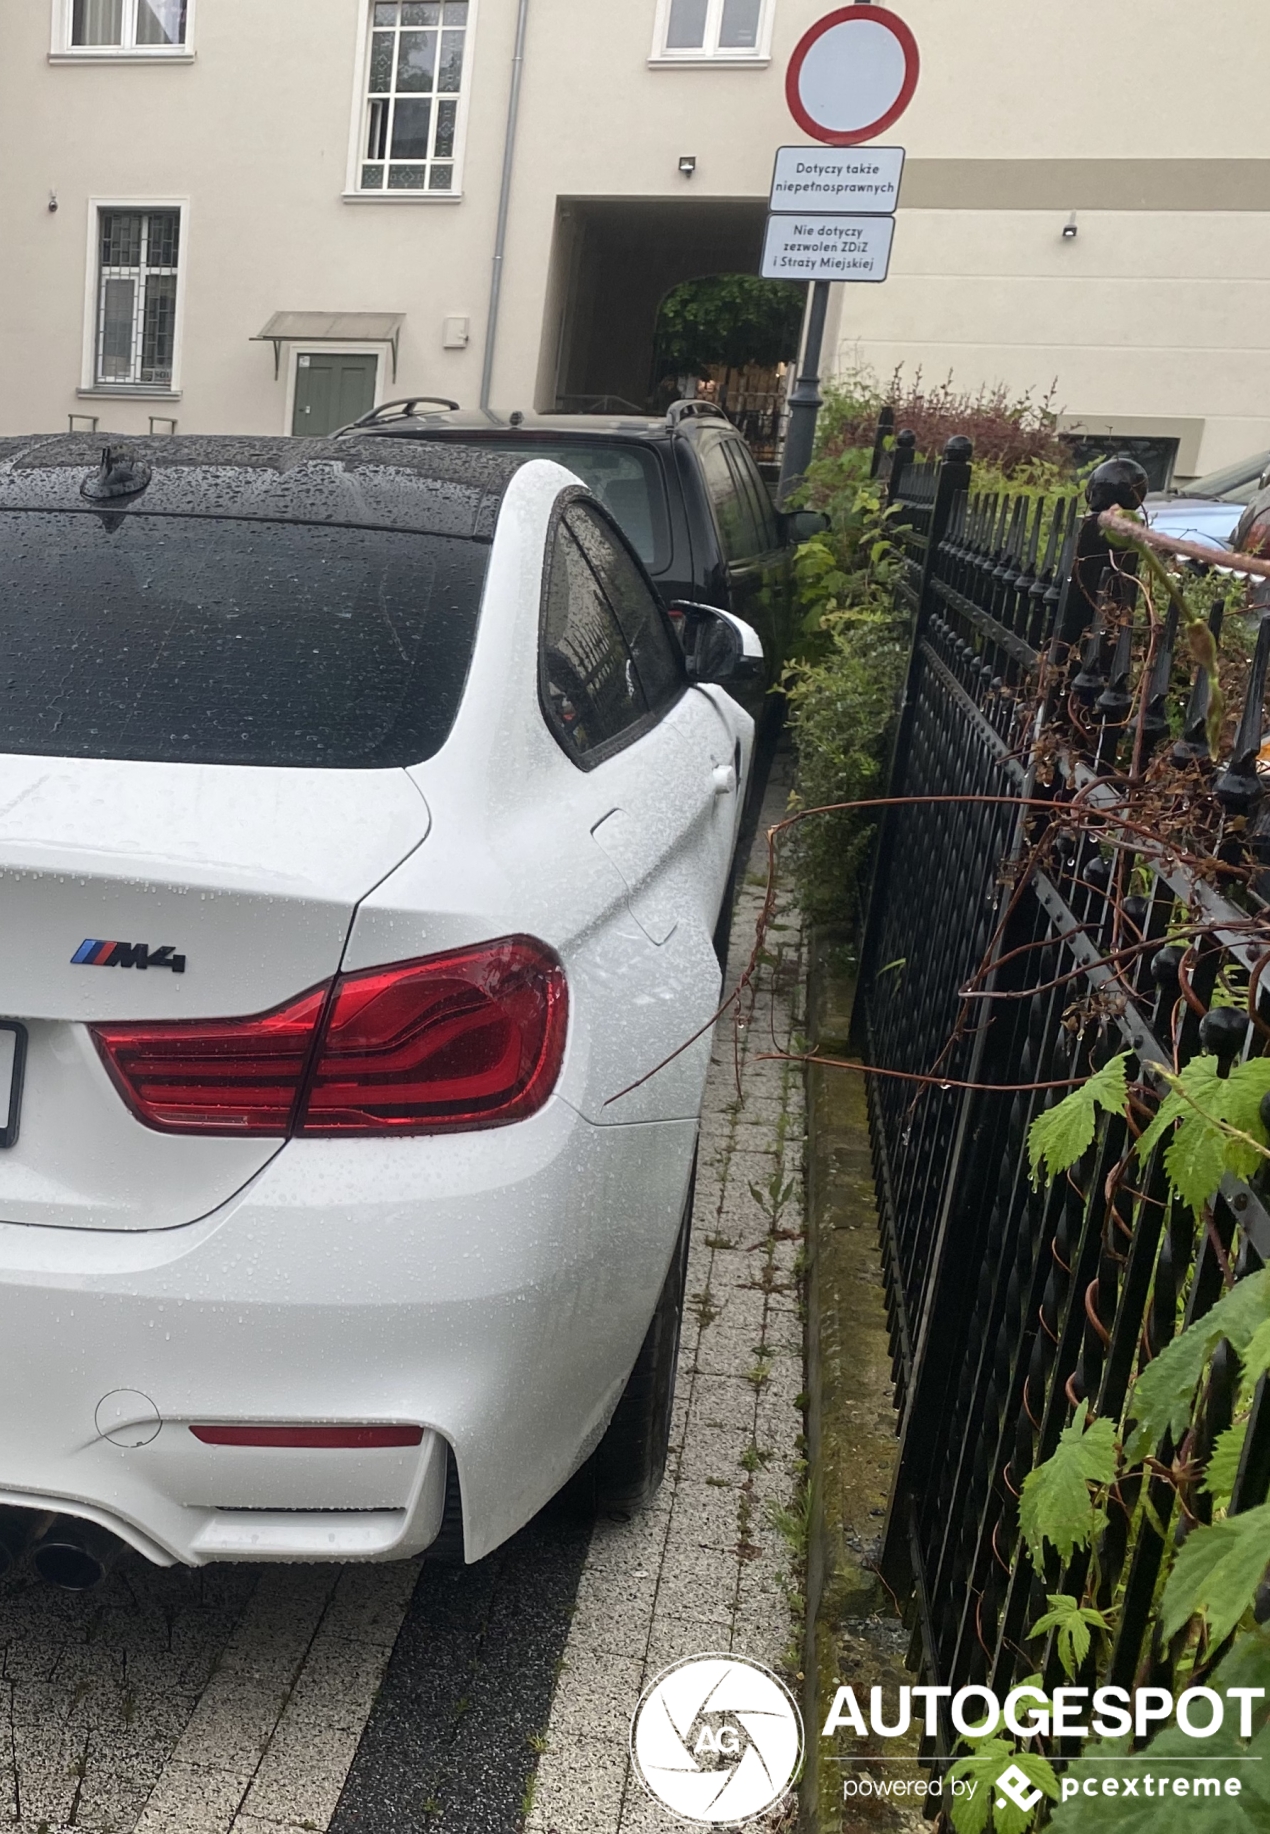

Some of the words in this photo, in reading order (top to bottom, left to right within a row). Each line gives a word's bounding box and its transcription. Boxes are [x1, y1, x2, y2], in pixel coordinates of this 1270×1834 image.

[796, 162, 843, 177] Dotyczy
[846, 162, 880, 175] także
[775, 181, 894, 195] niepełnosprawnych
[793, 225, 814, 236] Nie
[817, 225, 863, 239] dotyczy
[783, 242, 837, 252] zezwoleń
[841, 242, 868, 252] ZDiZ
[773, 256, 777, 266] i
[780, 256, 817, 270] Straży
[819, 257, 874, 271] Miejskiej
[105, 941, 186, 973] M4
